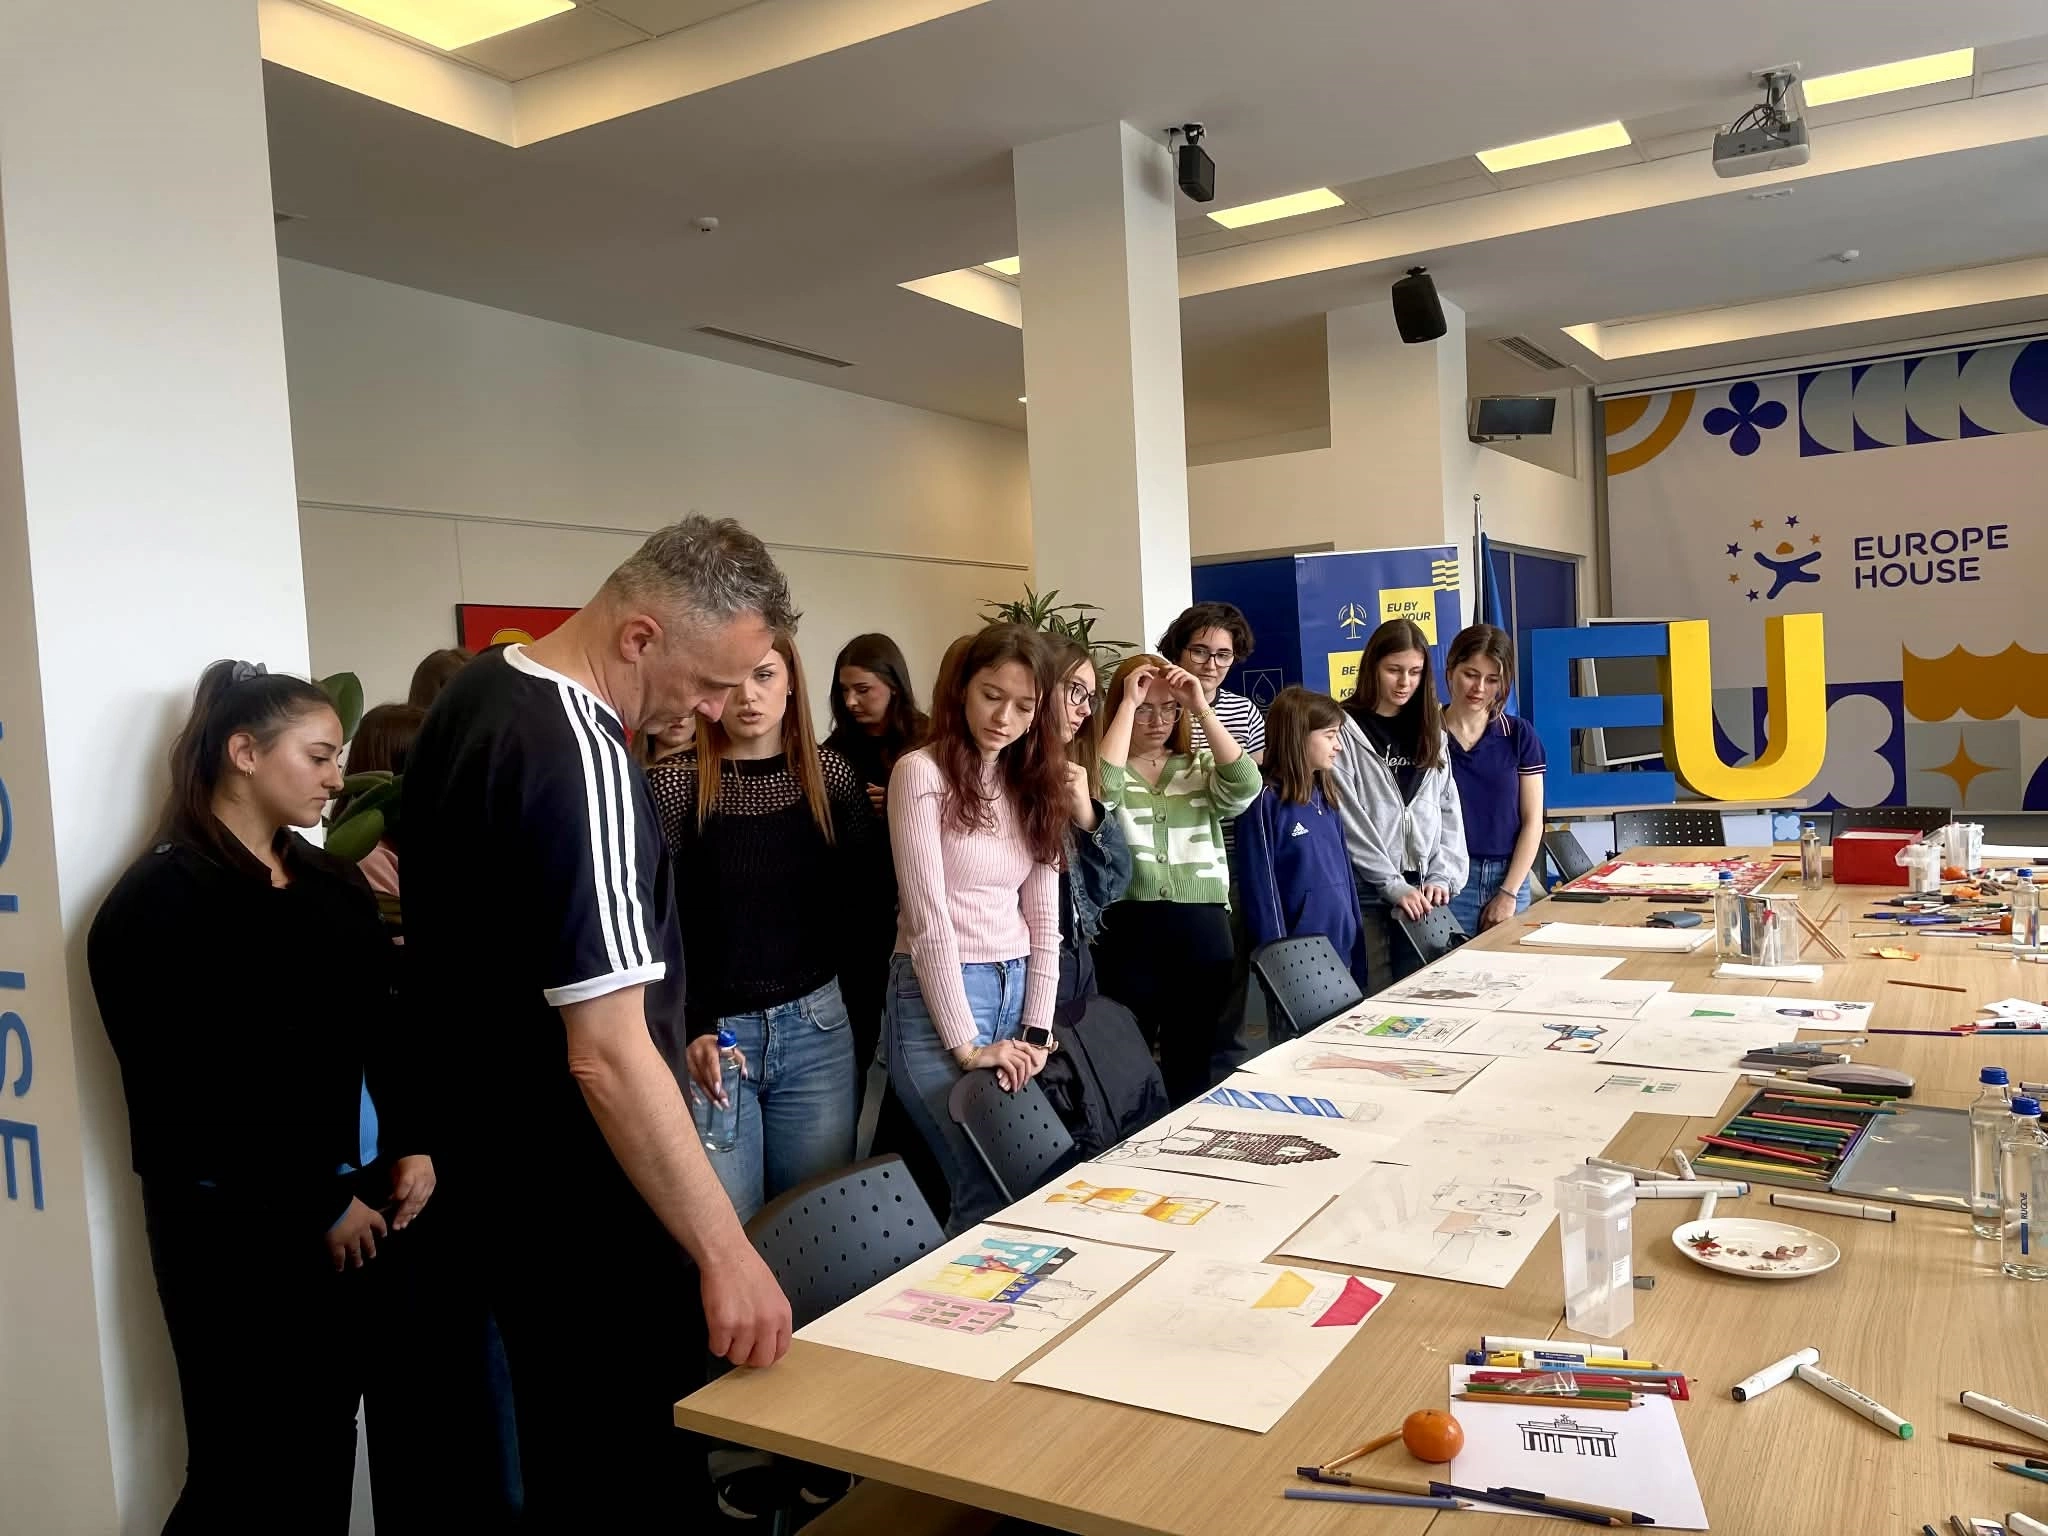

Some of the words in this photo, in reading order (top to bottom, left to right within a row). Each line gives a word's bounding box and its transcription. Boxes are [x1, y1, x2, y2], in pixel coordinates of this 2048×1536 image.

[1853, 524, 2009, 562] EUROPE
[1854, 556, 1981, 590] HOUSE
[1387, 602, 1402, 612] EU
[1404, 601, 1418, 611] BY
[1402, 611, 1431, 621] YOUR
[1341, 666, 1359, 676] BE-
[1531, 612, 1828, 808] EU
